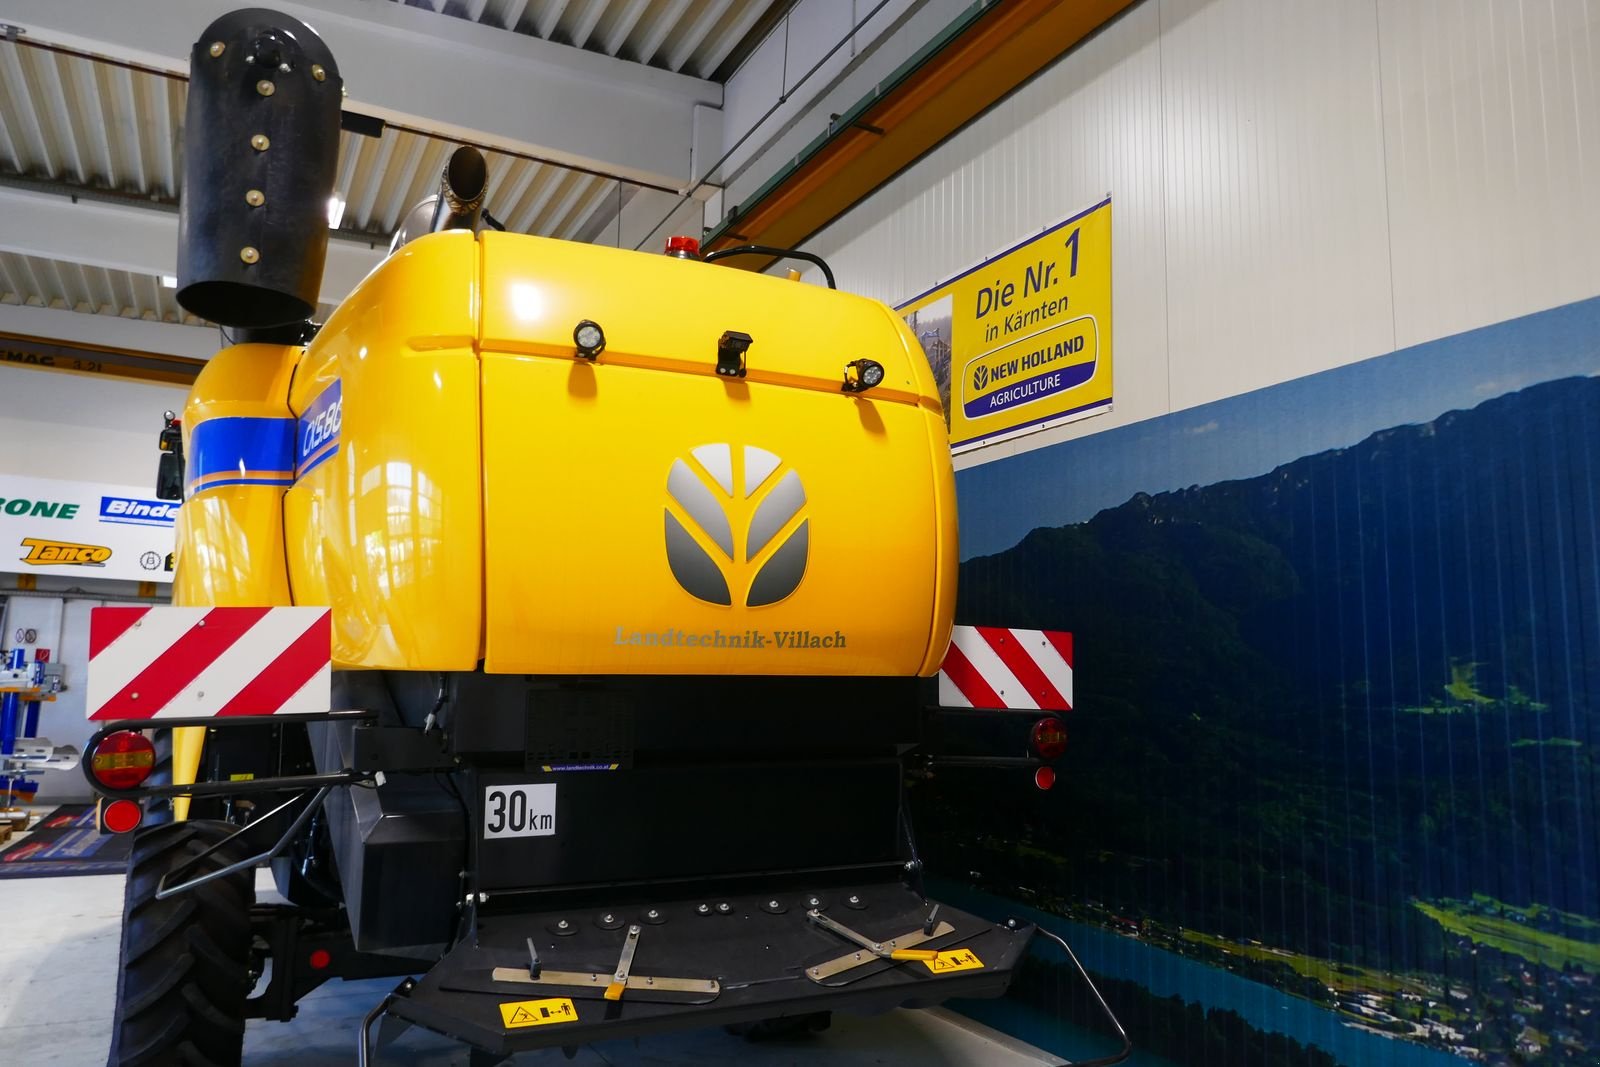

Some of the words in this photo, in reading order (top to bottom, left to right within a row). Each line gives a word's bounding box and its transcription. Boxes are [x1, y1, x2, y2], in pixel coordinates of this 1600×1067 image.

[976, 280, 1015, 320] Die
[1023, 260, 1059, 298] Nr.
[1064, 227, 1081, 278] 1
[985, 323, 999, 343] in
[1004, 296, 1069, 336] Kärnten
[990, 360, 1018, 383] NEW
[1021, 335, 1084, 372] HOLLAND
[989, 374, 1061, 408] AGRICULTURE
[21, 537, 112, 566] Tanco
[613, 626, 847, 649] Landtechnik-Villach
